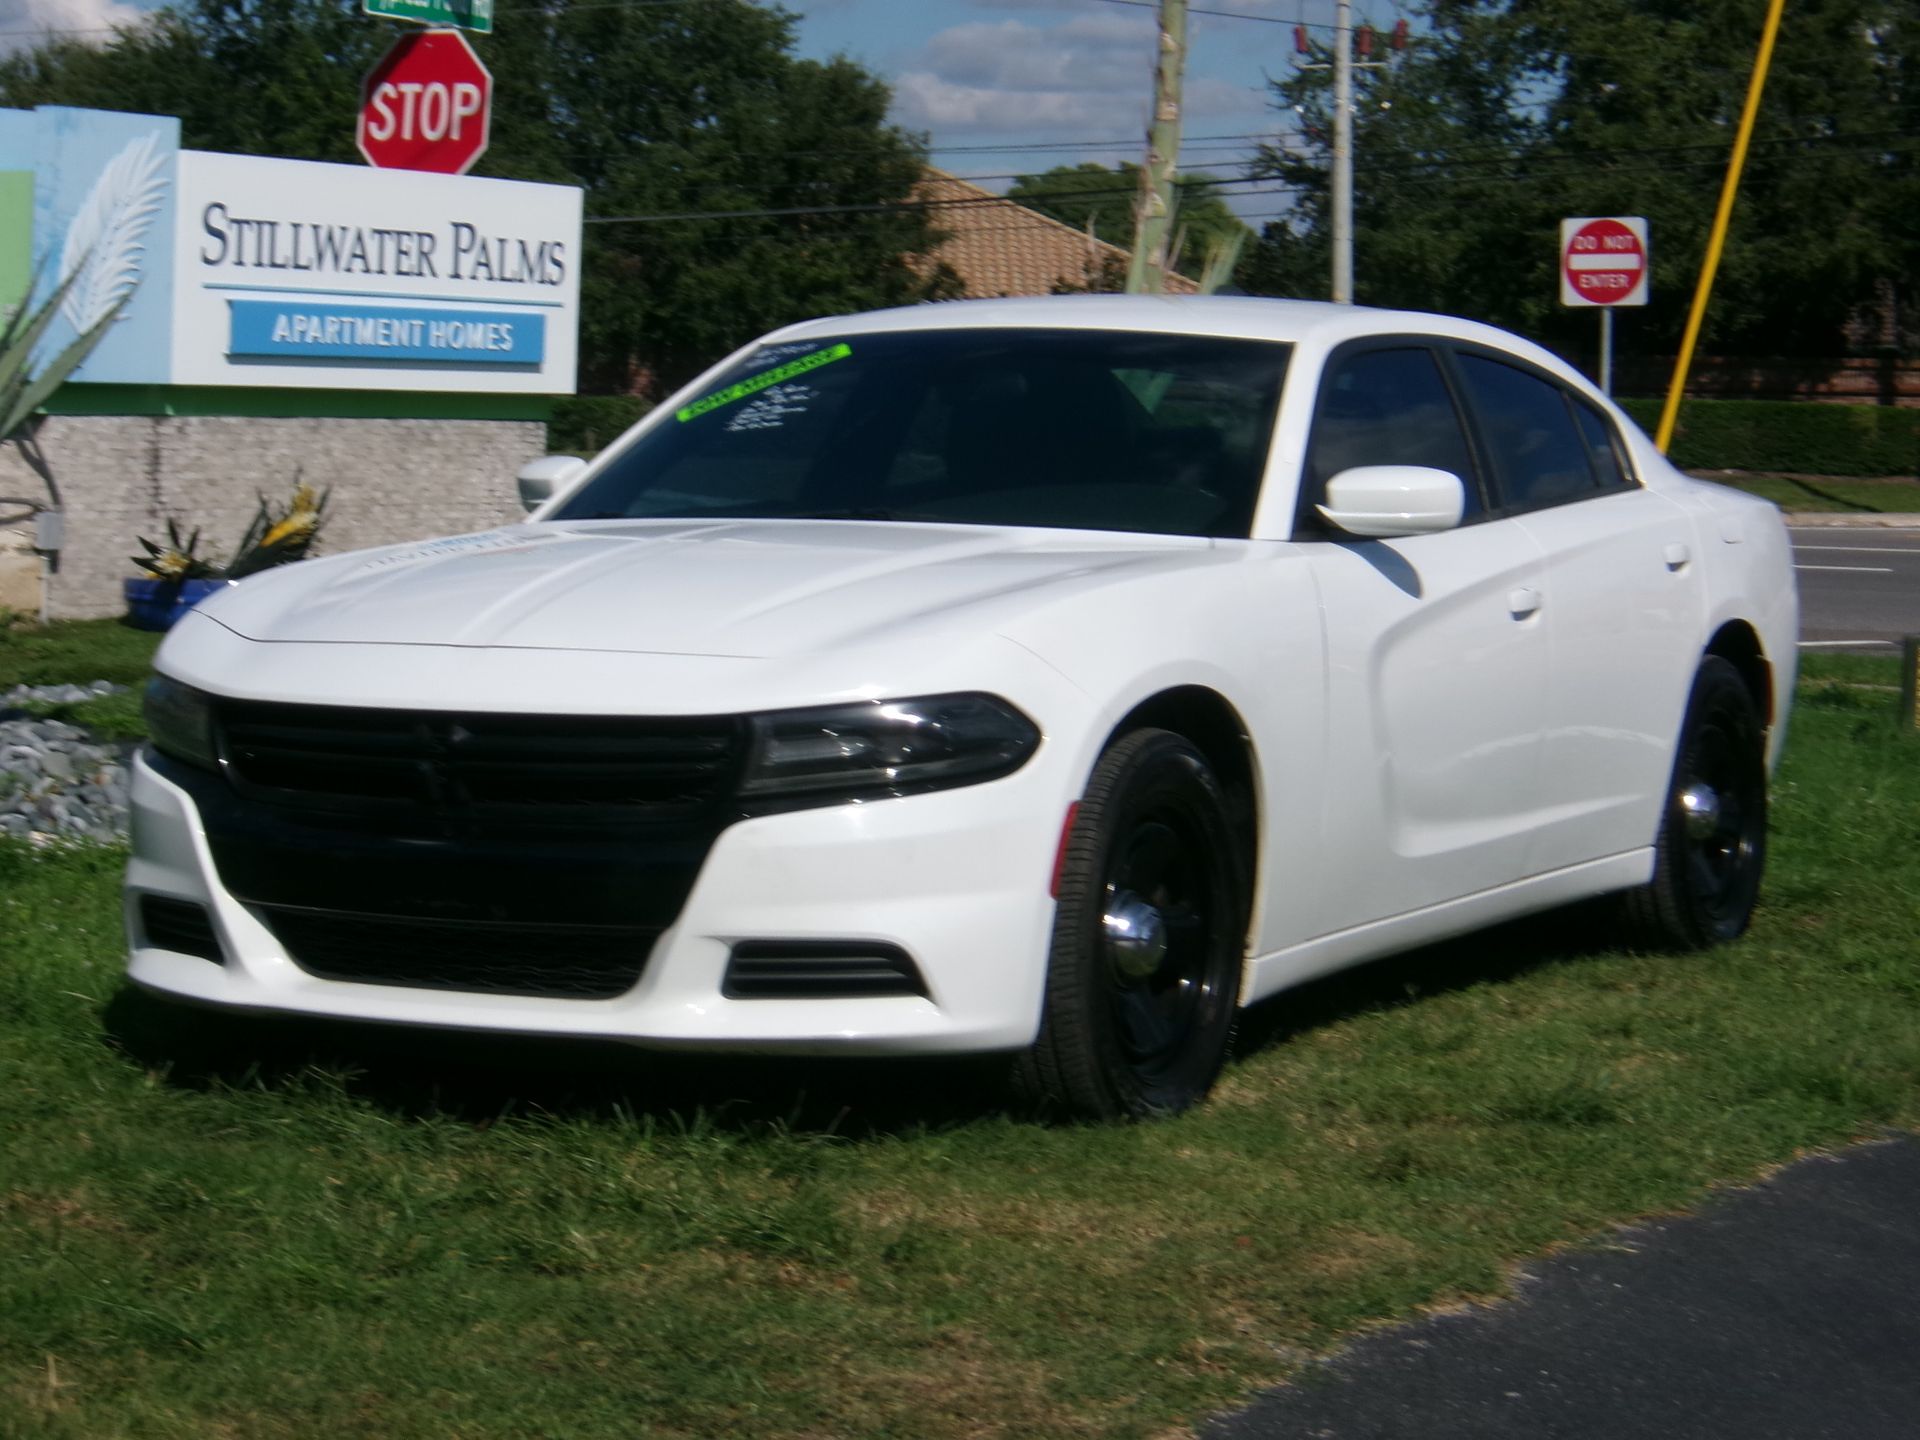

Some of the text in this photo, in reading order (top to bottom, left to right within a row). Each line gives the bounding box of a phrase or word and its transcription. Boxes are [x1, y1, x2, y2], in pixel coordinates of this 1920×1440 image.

[367, 81, 482, 141] STOP
[201, 201, 566, 286] STILLWATER PALMS
[1574, 234, 1634, 250] DO NOT
[1579, 273, 1629, 288] ENTER
[271, 313, 513, 352] APARTMENT HOMES
